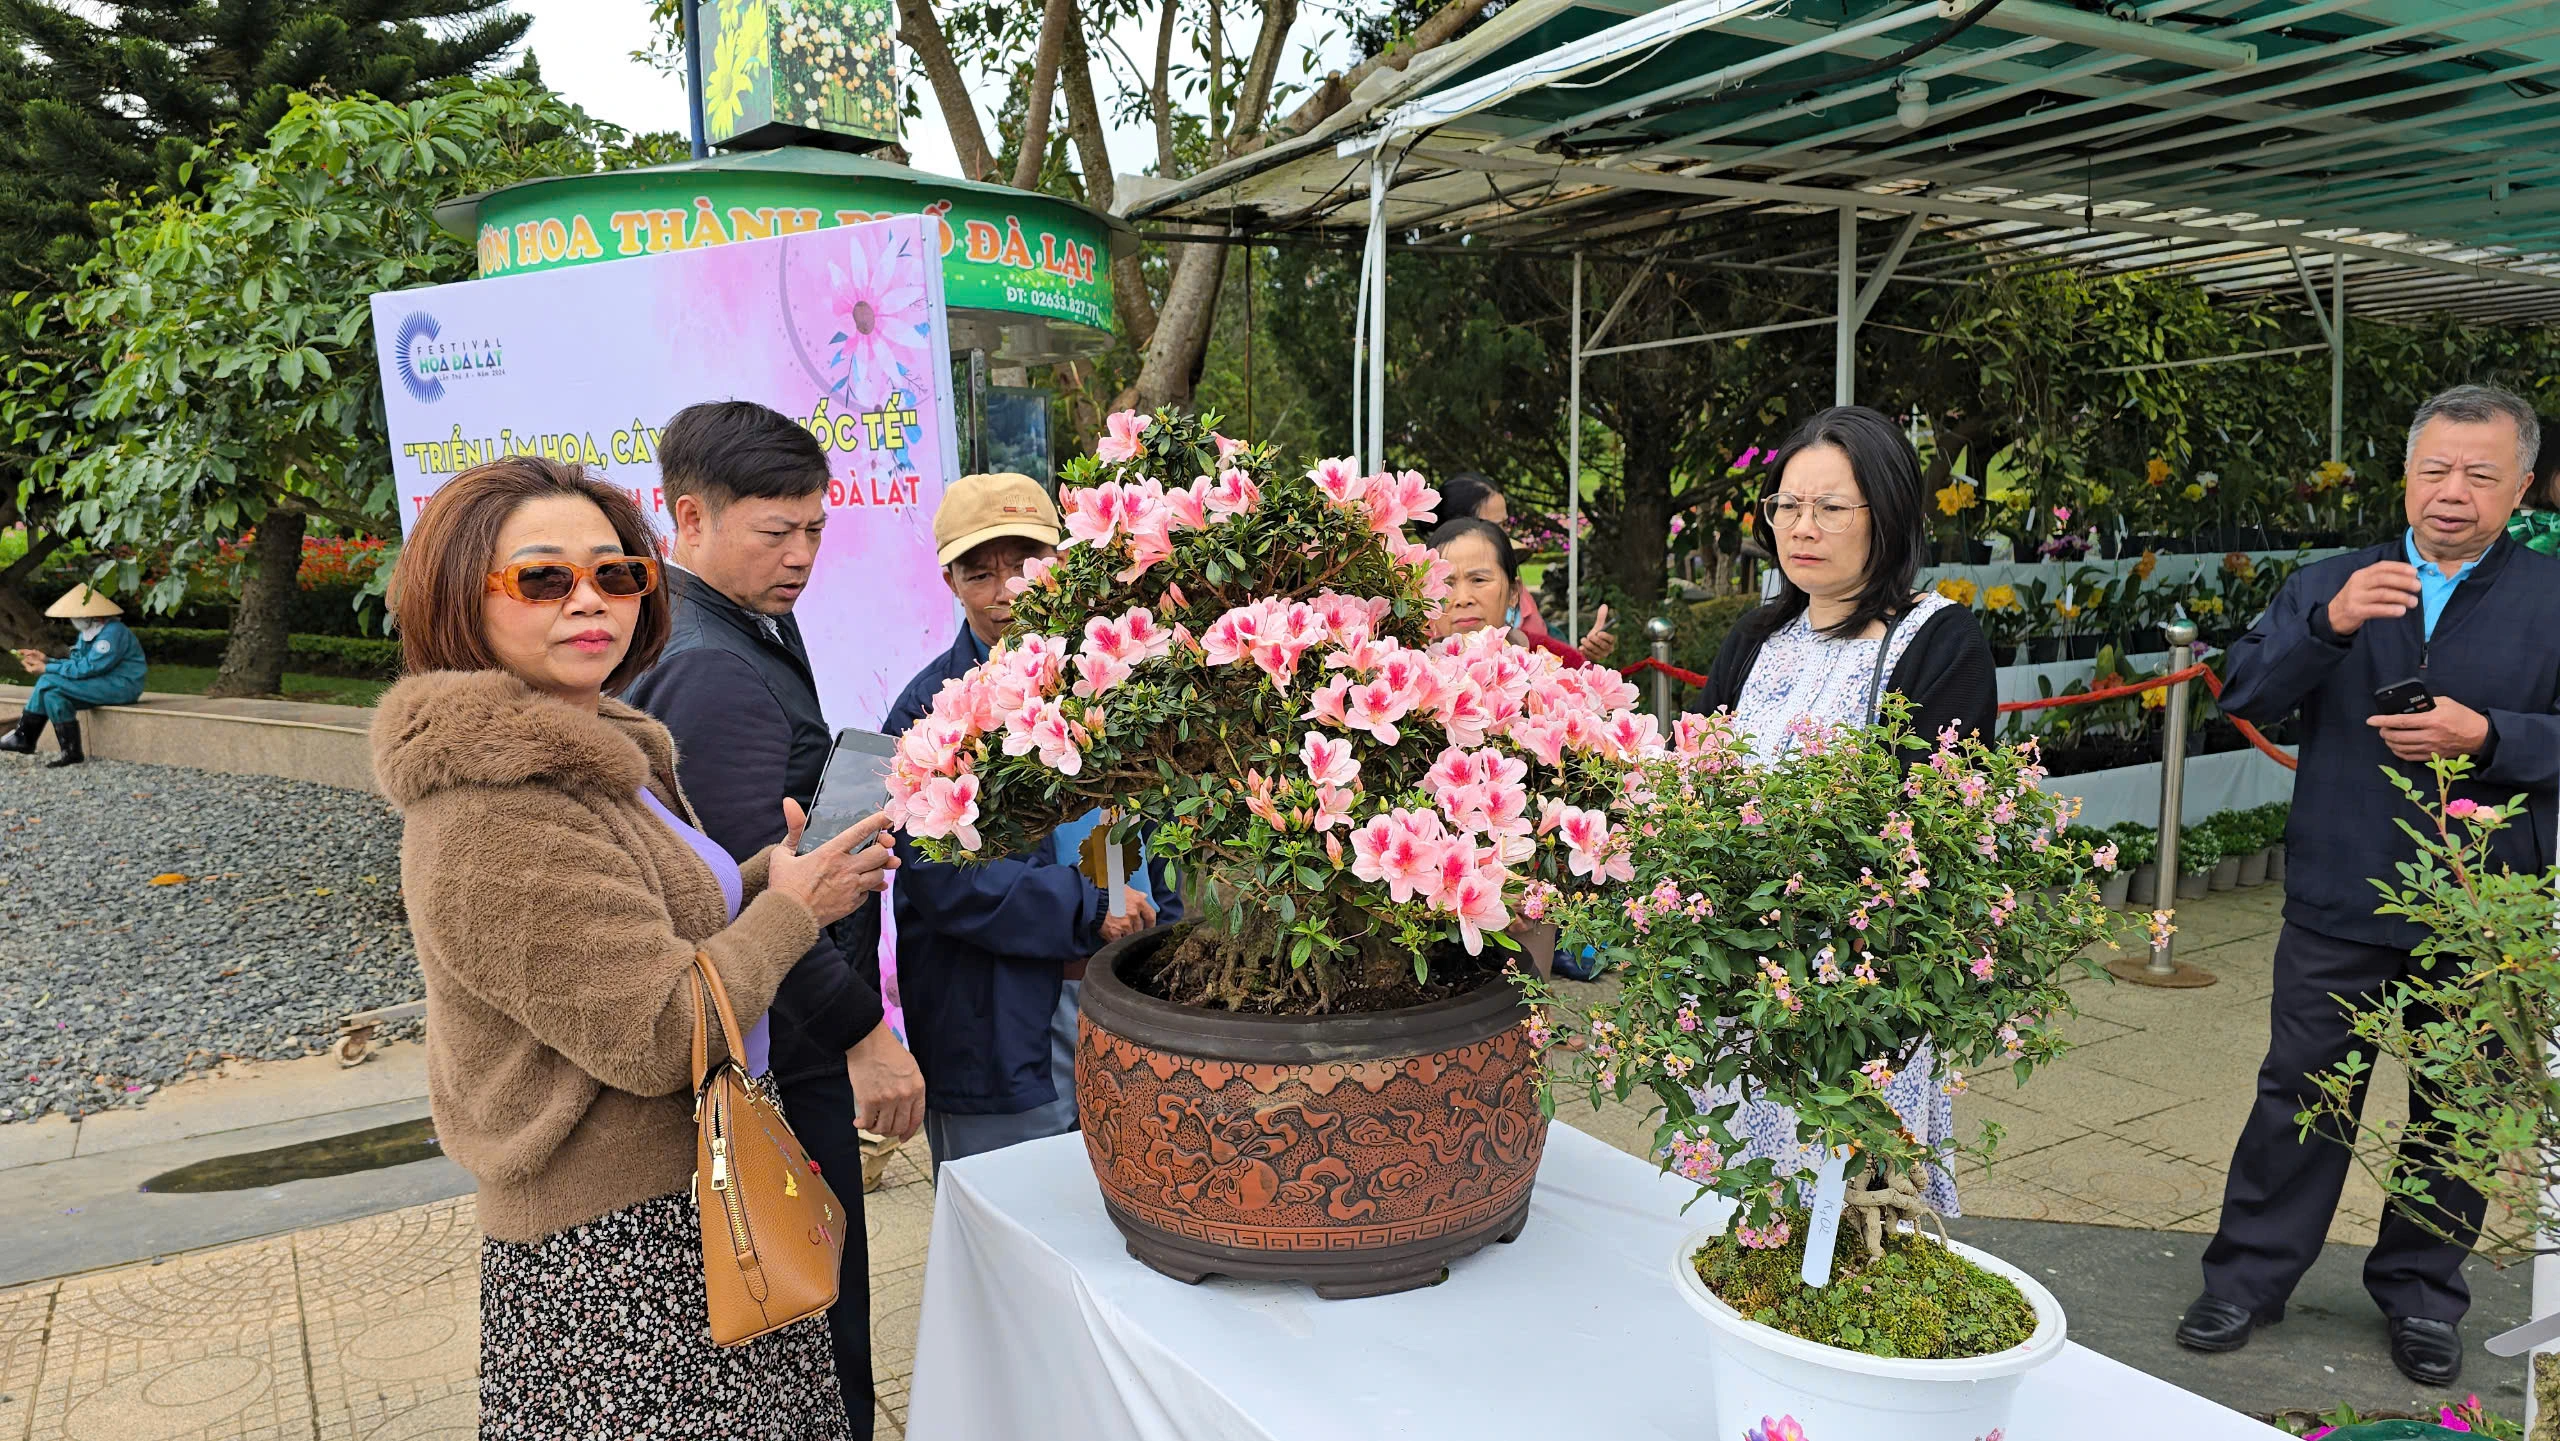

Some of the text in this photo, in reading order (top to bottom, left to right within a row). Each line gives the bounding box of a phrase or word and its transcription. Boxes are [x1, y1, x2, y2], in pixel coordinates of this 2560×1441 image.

[515, 214, 603, 266] HOA
[965, 215, 1034, 269] ĐÀ
[1040, 232, 1096, 288] LẠT
[1006, 286, 1027, 304] ĐT:
[416, 337, 502, 356] FESTIVAL
[419, 355, 450, 374] HOA
[475, 349, 502, 370] LẠT
[541, 432, 608, 470] HOA,
[829, 470, 920, 513] ĐÀ LẠT
